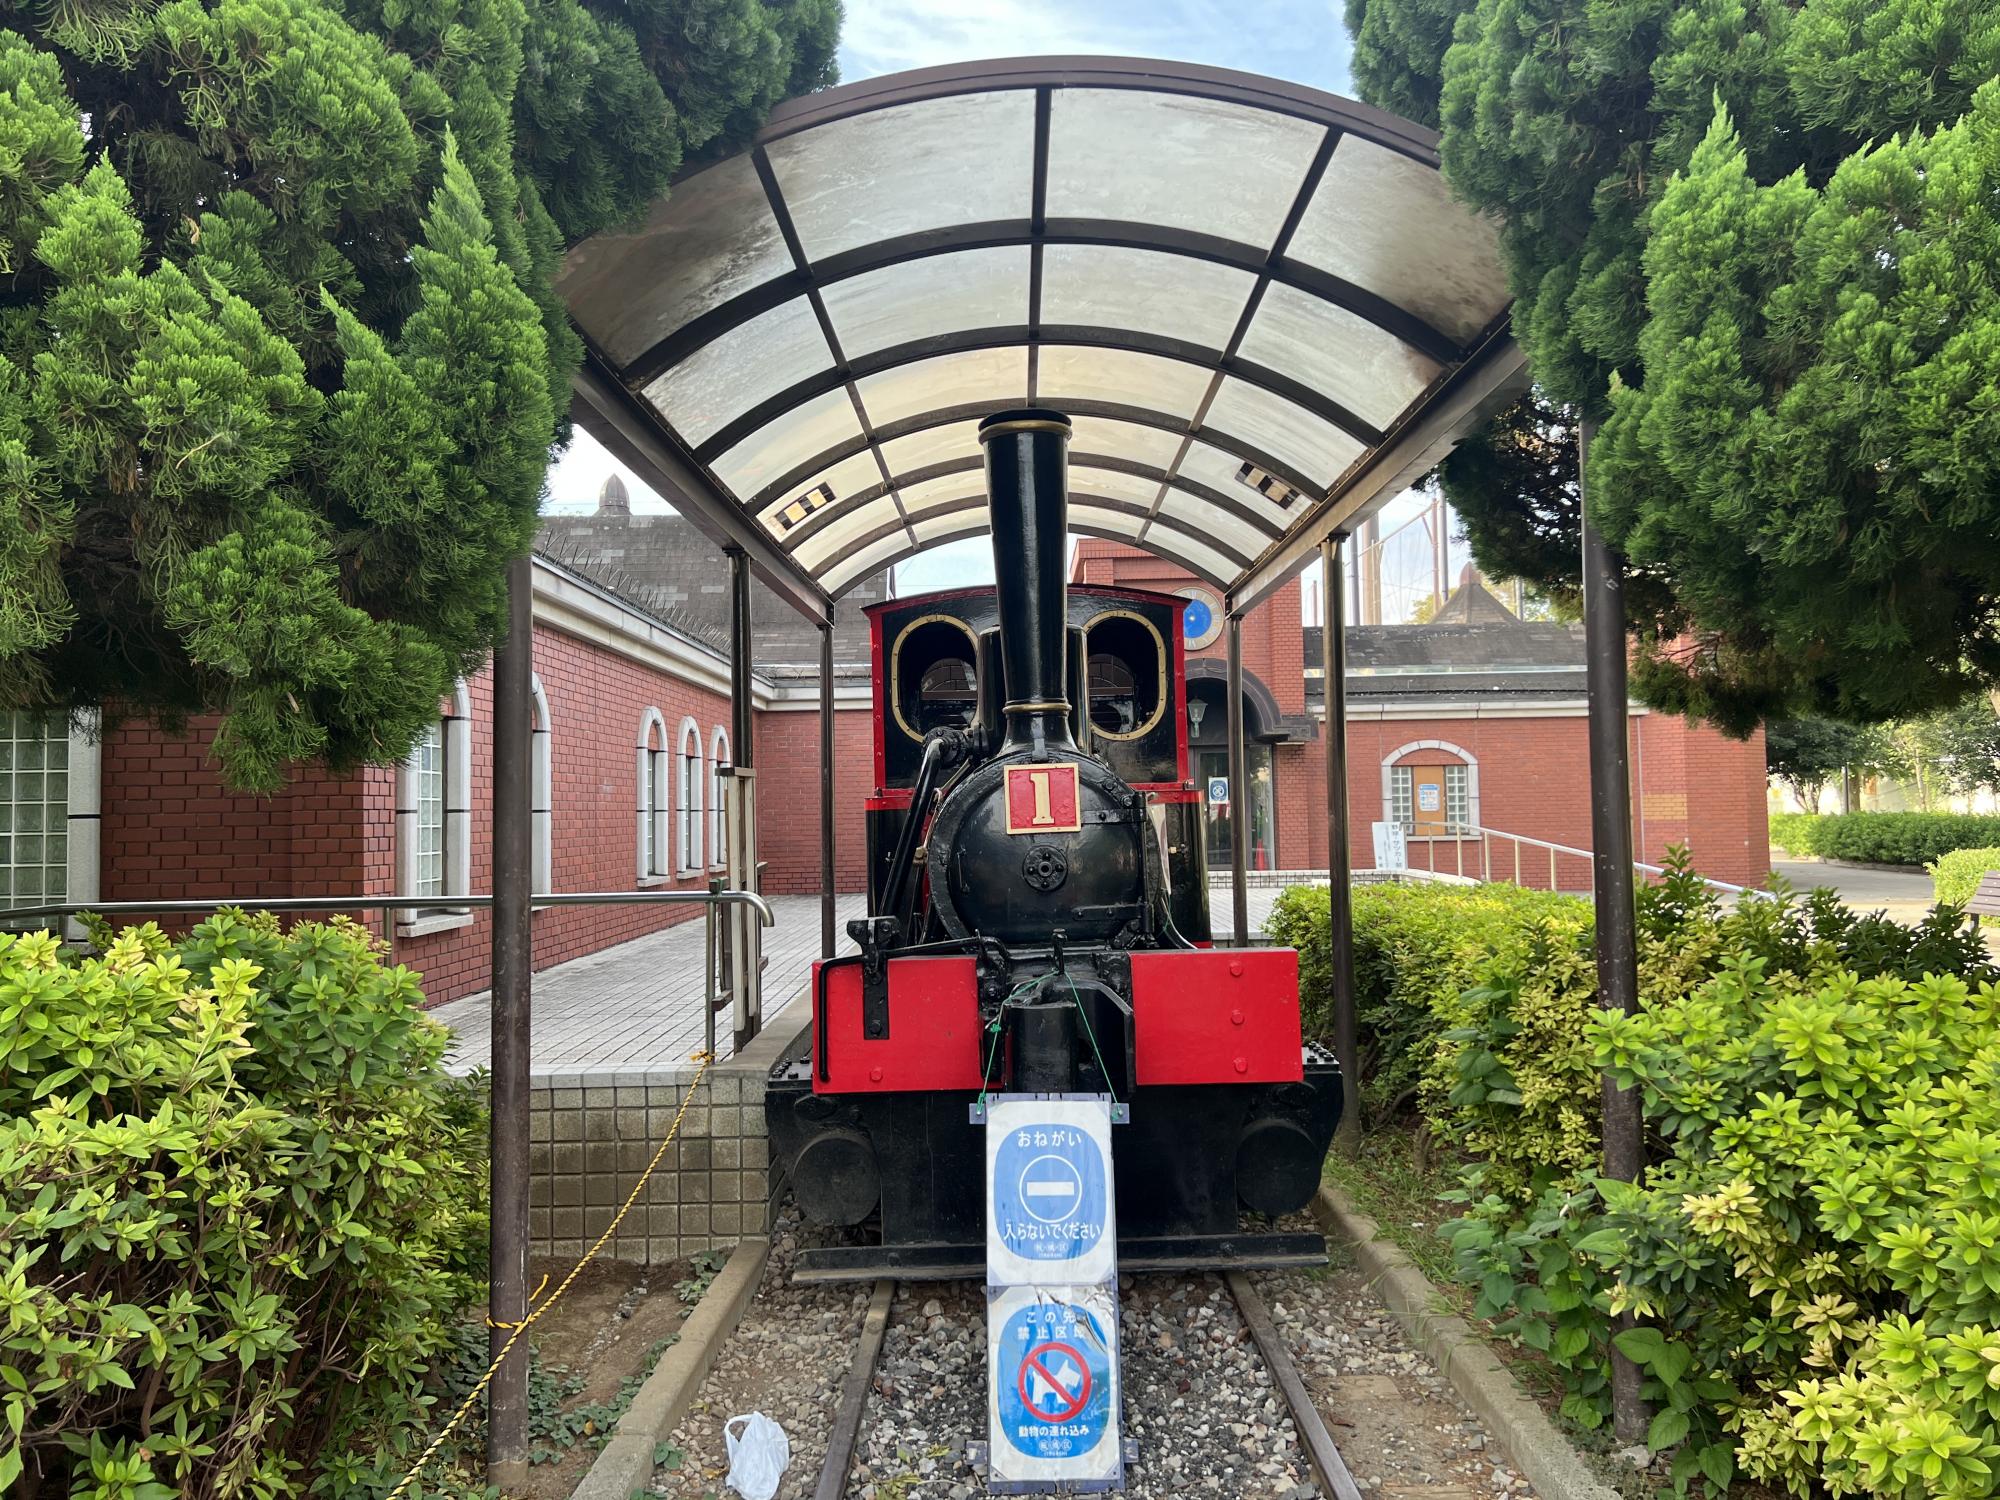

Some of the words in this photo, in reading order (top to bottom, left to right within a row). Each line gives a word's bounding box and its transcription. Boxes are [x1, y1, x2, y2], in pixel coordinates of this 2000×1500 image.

[1030, 772, 1055, 825] 1
[1017, 1131, 1082, 1147] おねがい
[1003, 1222, 1101, 1240] 入らないでください
[1018, 1425, 1090, 1438] 動物の連れ込み
